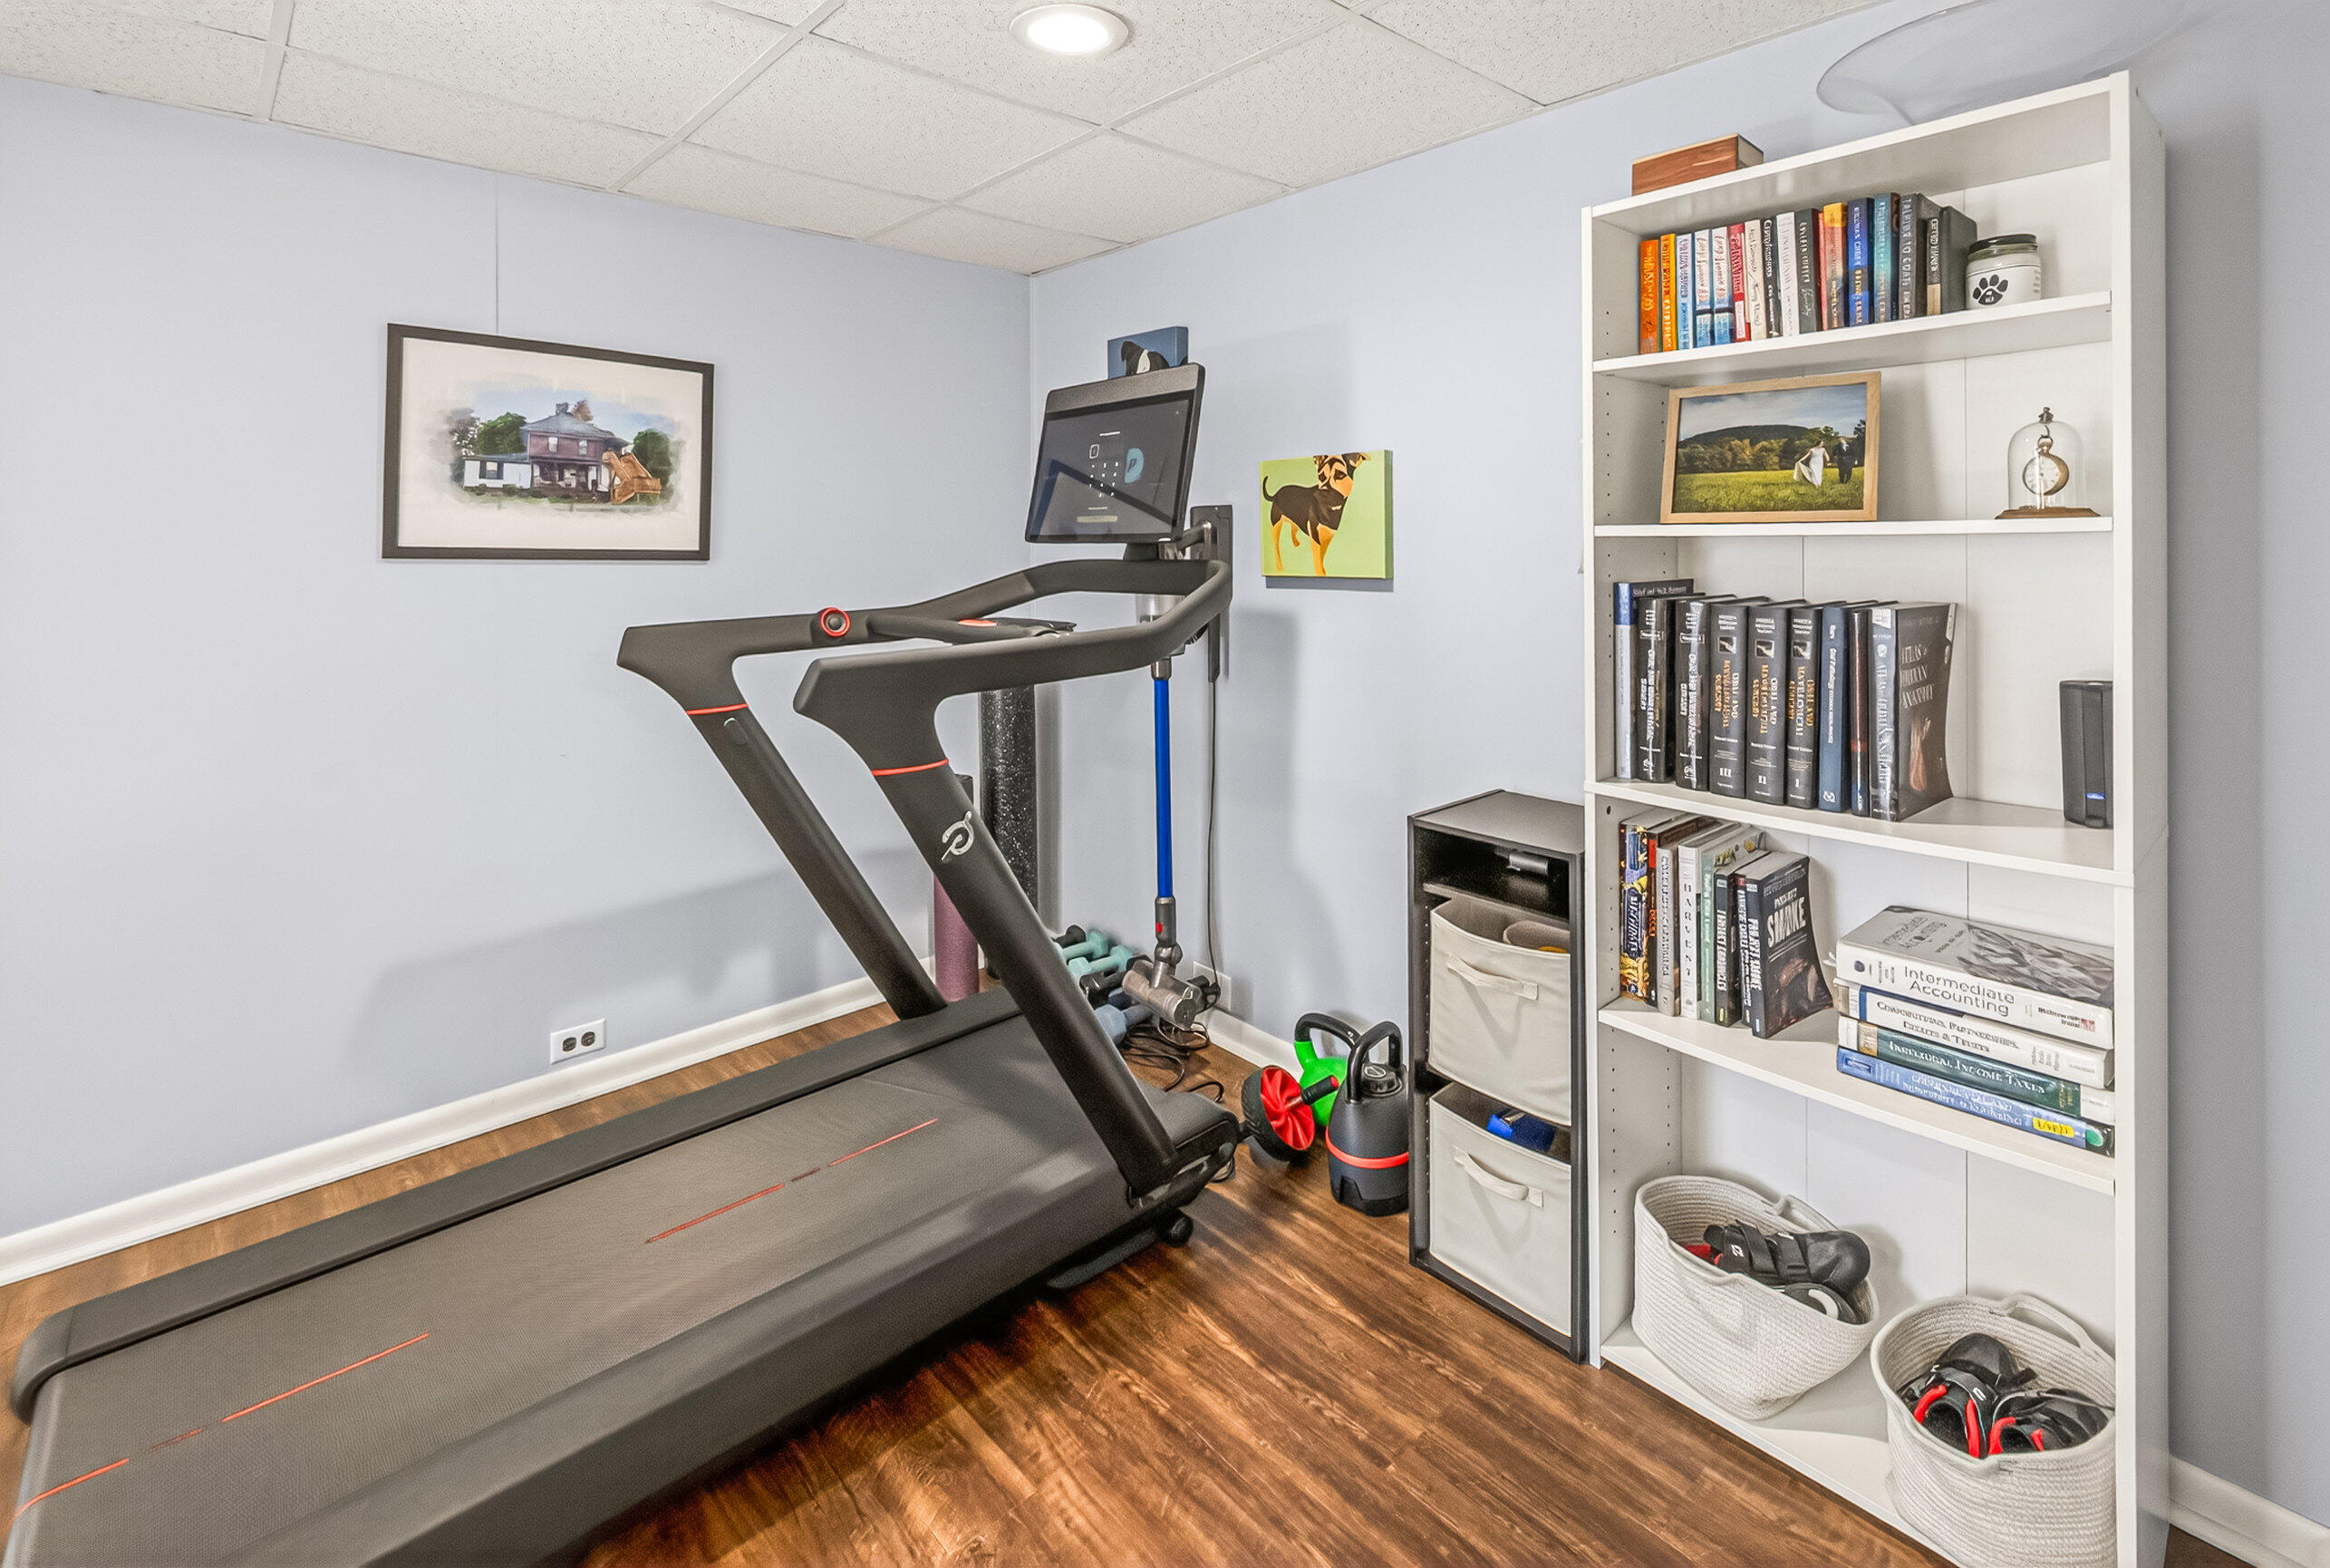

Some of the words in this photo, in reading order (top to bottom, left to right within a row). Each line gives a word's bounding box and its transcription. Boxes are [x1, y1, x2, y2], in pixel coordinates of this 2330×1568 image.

[1766, 896, 1806, 948] SMOKE
[1904, 965, 2015, 1004] Intermediate
[1909, 980, 2009, 1017] Accounting
